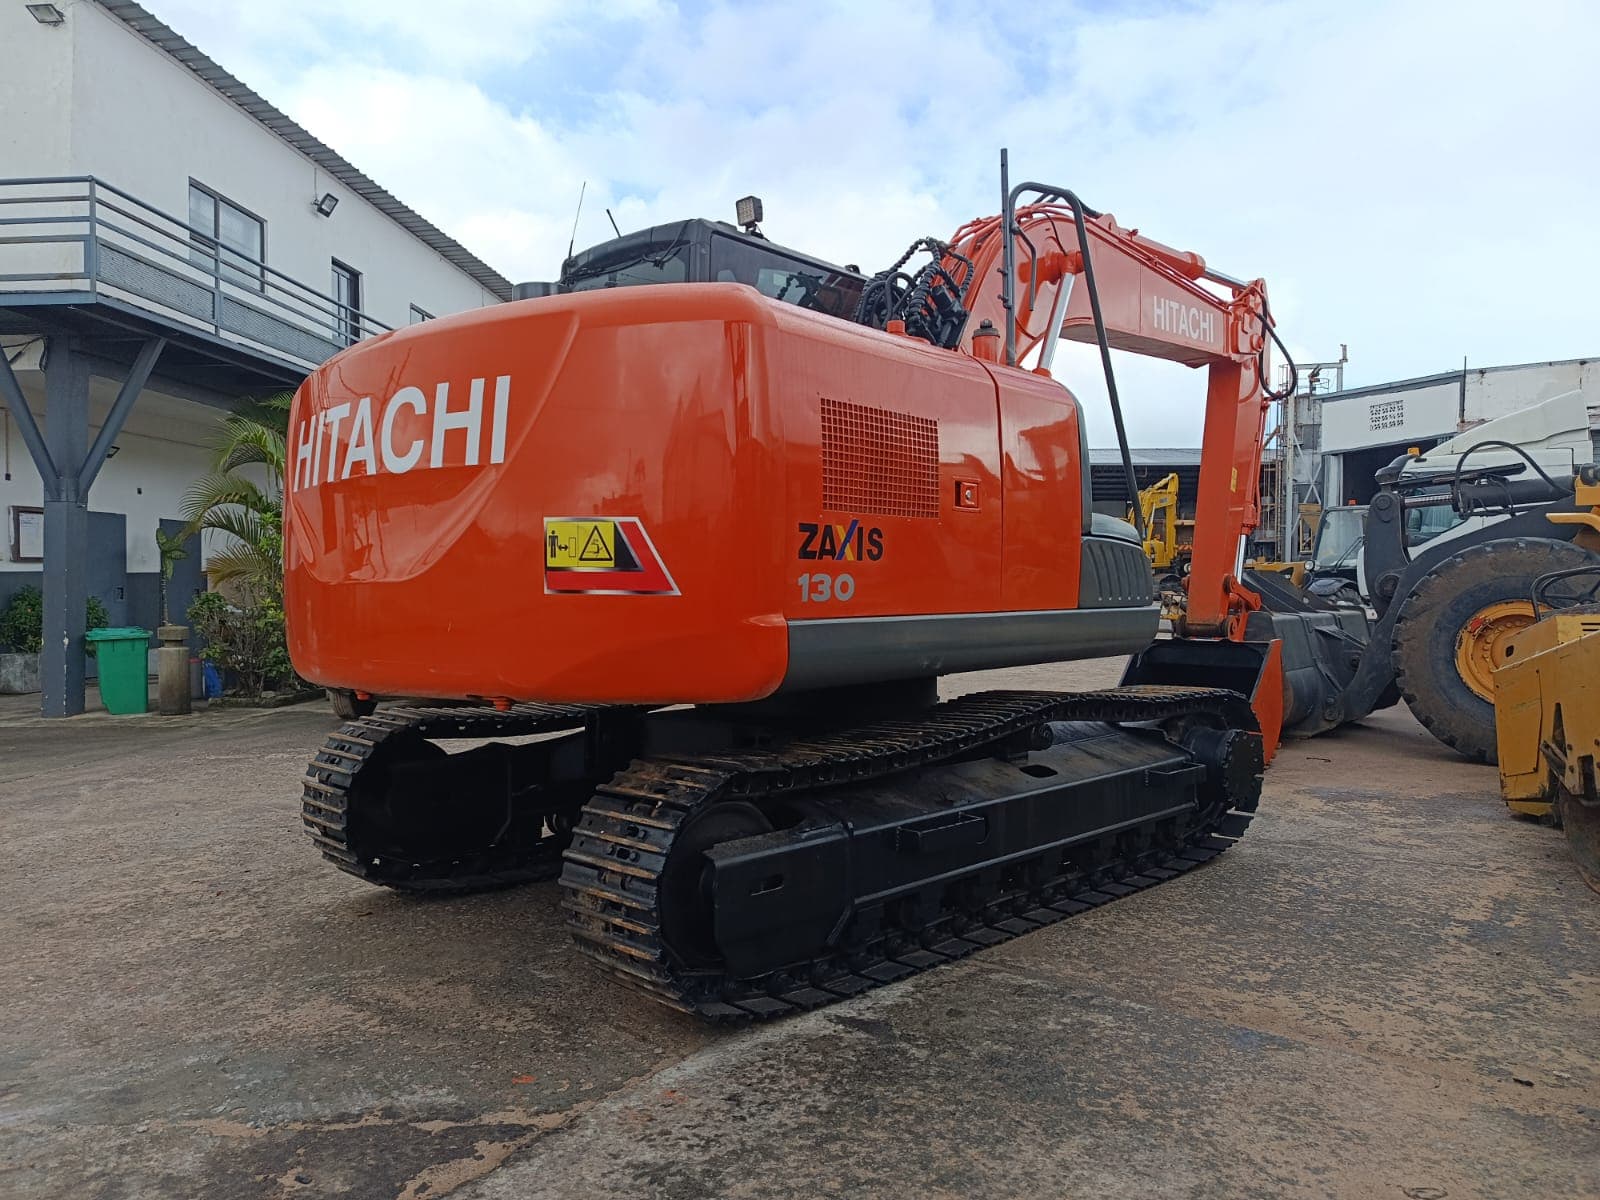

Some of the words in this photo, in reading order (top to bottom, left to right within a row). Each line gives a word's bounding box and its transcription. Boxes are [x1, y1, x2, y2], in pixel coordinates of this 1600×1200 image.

[1153, 296, 1214, 343] HITACHI
[293, 374, 511, 493] HITACHI
[799, 520, 883, 561] ZAXIS
[798, 573, 855, 602] 130
